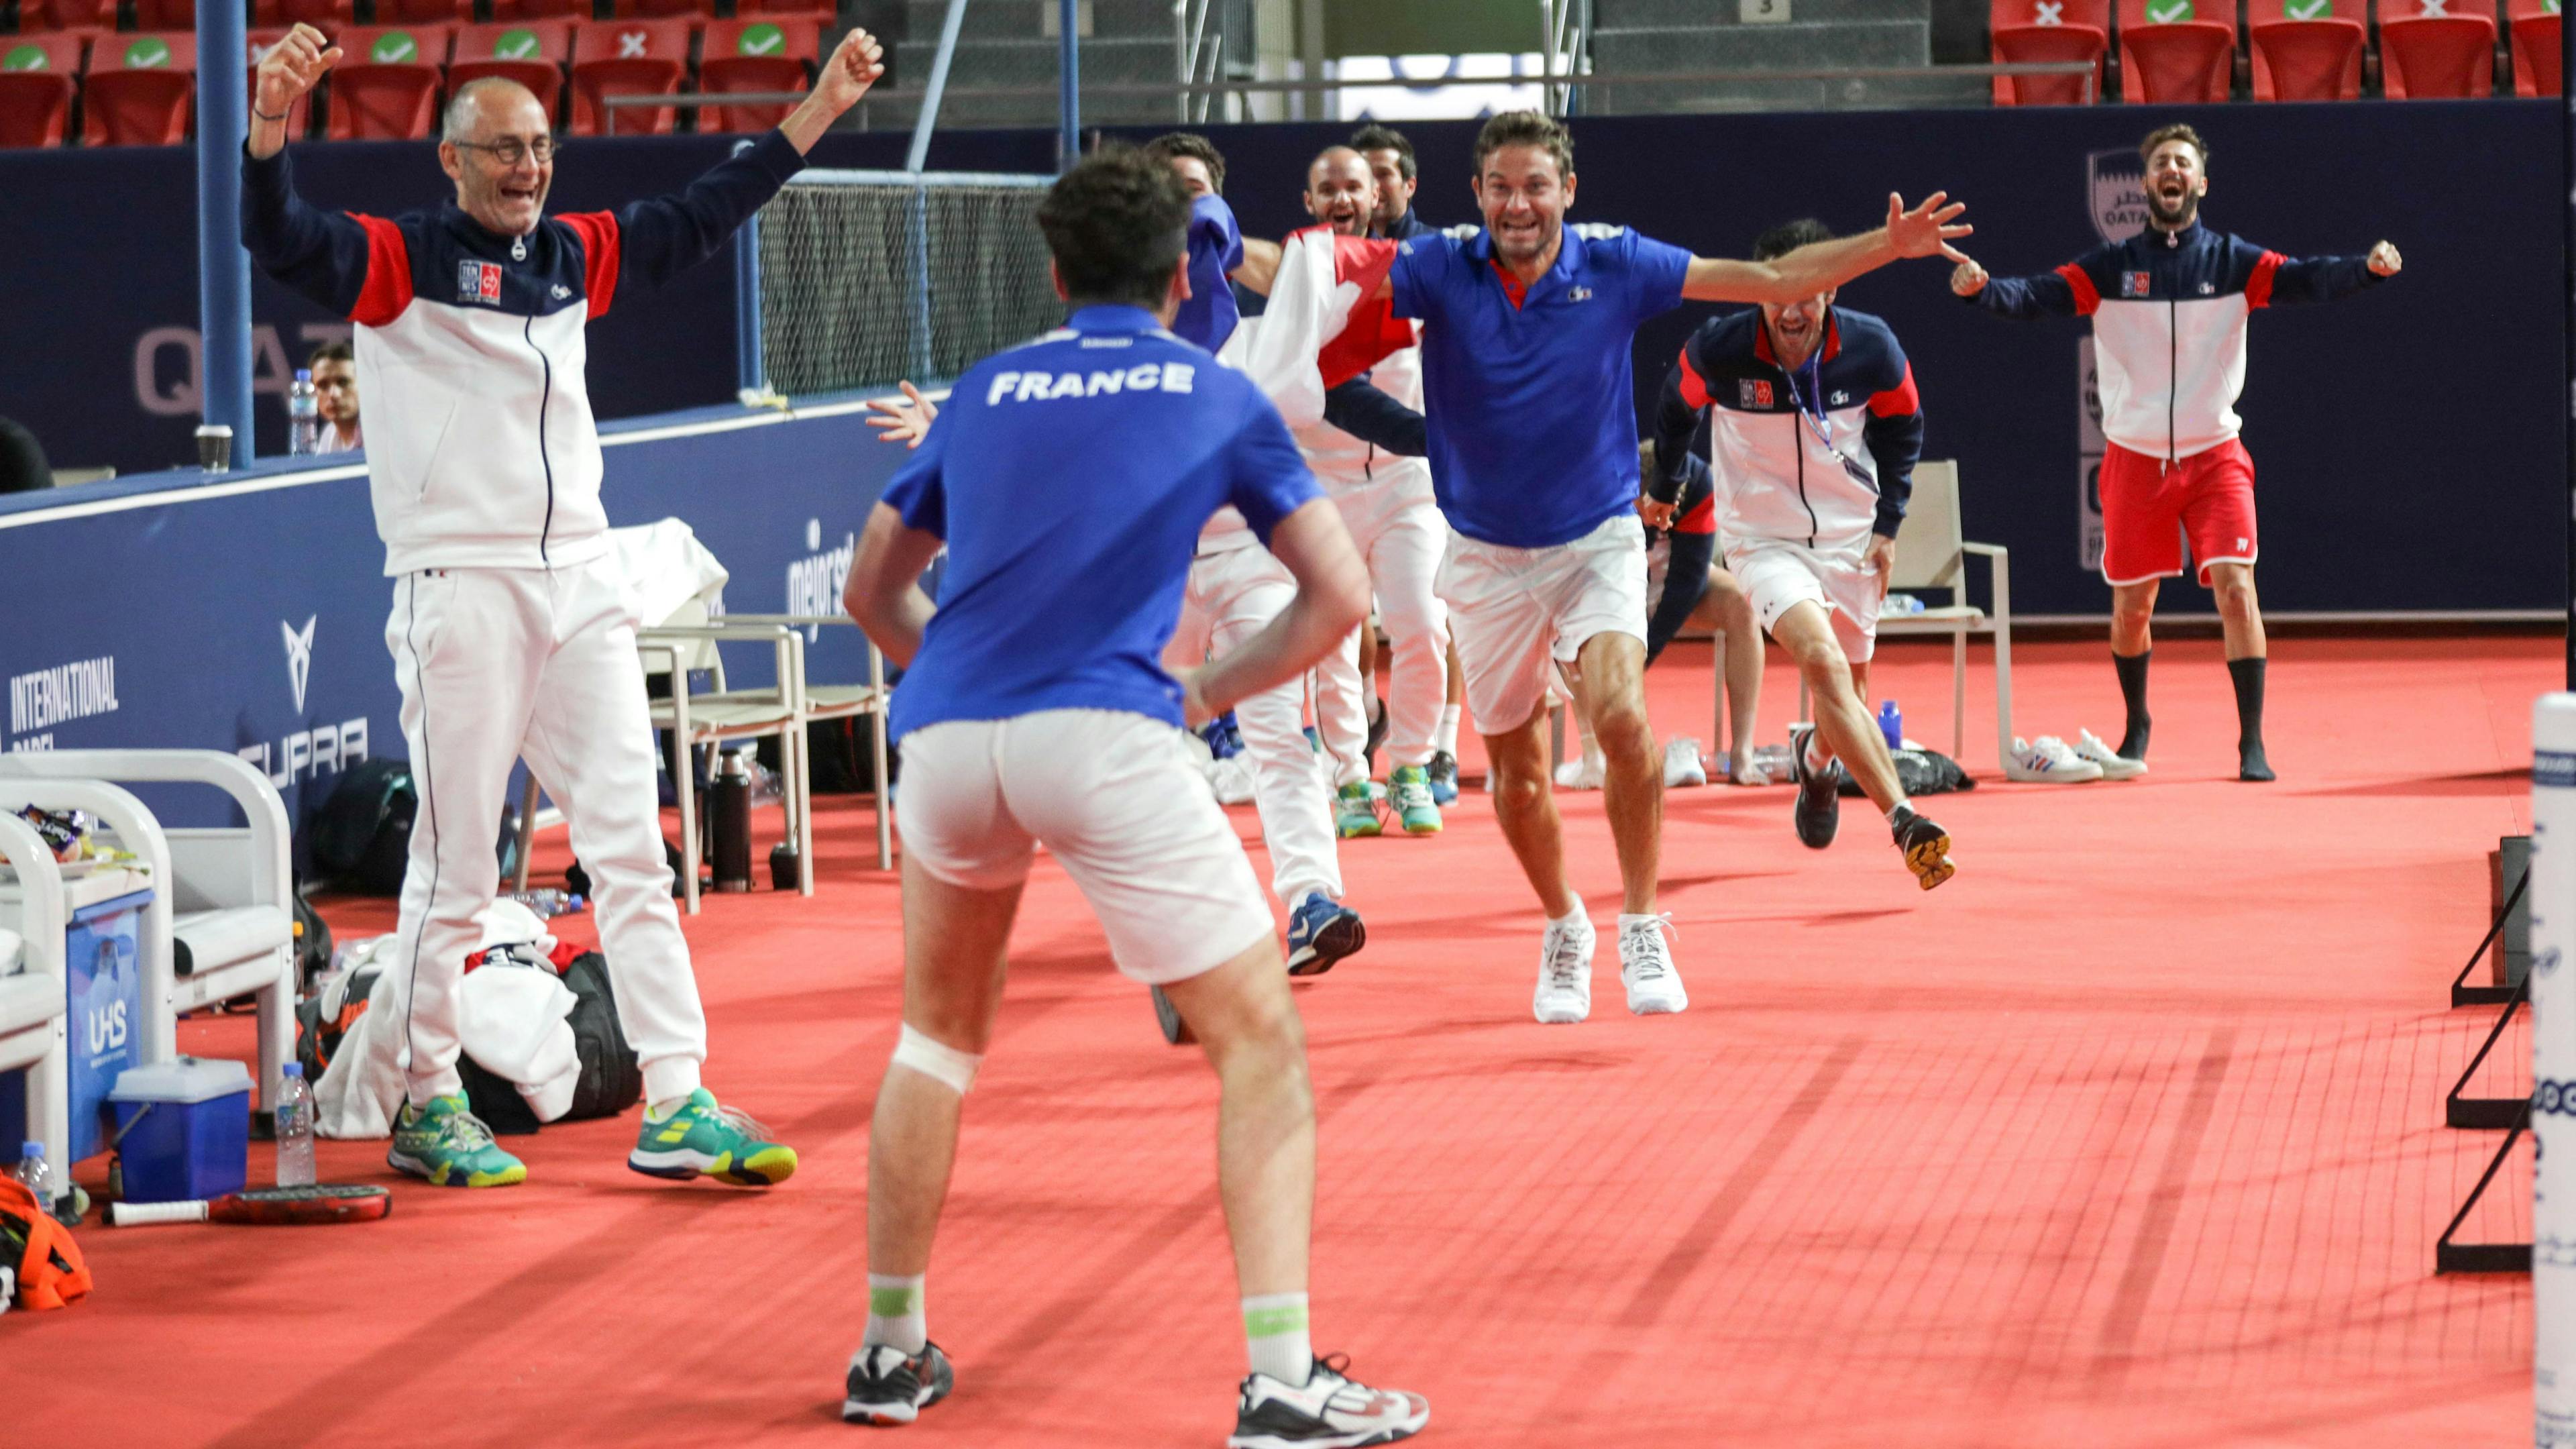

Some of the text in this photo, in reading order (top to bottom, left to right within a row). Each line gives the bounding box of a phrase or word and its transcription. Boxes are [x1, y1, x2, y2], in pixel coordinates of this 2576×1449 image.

[986, 362, 1196, 407] FRANCE
[10, 655, 119, 735] INTERNATIONAL
[89, 998, 127, 1055] UHS
